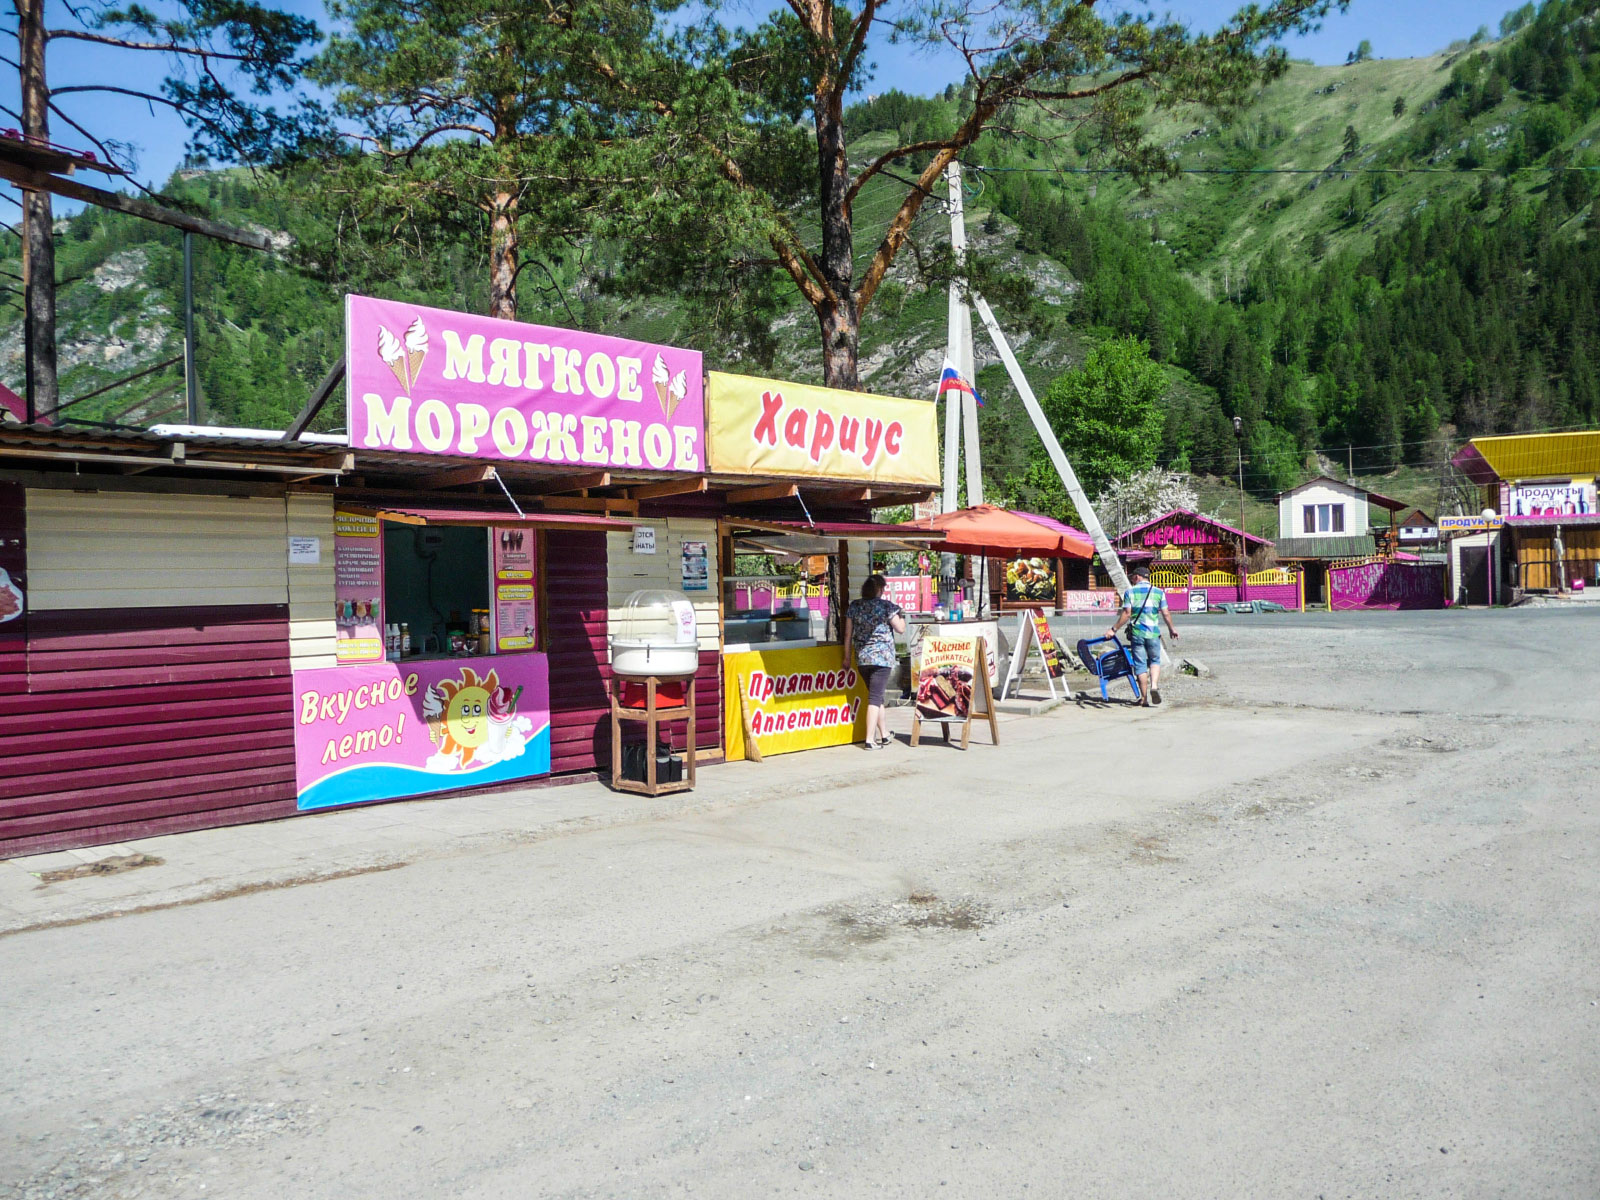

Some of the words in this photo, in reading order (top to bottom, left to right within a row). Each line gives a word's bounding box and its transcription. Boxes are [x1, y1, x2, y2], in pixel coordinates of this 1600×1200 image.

[442, 329, 643, 403] МЯГКОЕ
[362, 392, 699, 472] МОРОЖЕНОЕ
[752, 390, 904, 468] Хариус
[1515, 487, 1581, 499] Продукты
[1441, 517, 1503, 527] ПРОДУКЫ
[884, 581, 916, 592] дам
[904, 593, 916, 601] 07
[904, 602, 916, 610] 03
[928, 641, 972, 653] Мясные
[924, 654, 974, 666] ДЕЛИКАТЕСЫ
[749, 669, 857, 702] Приятного
[299, 672, 420, 725] Вкусное
[751, 697, 860, 736] Аппетита!
[320, 711, 407, 766] лето!
